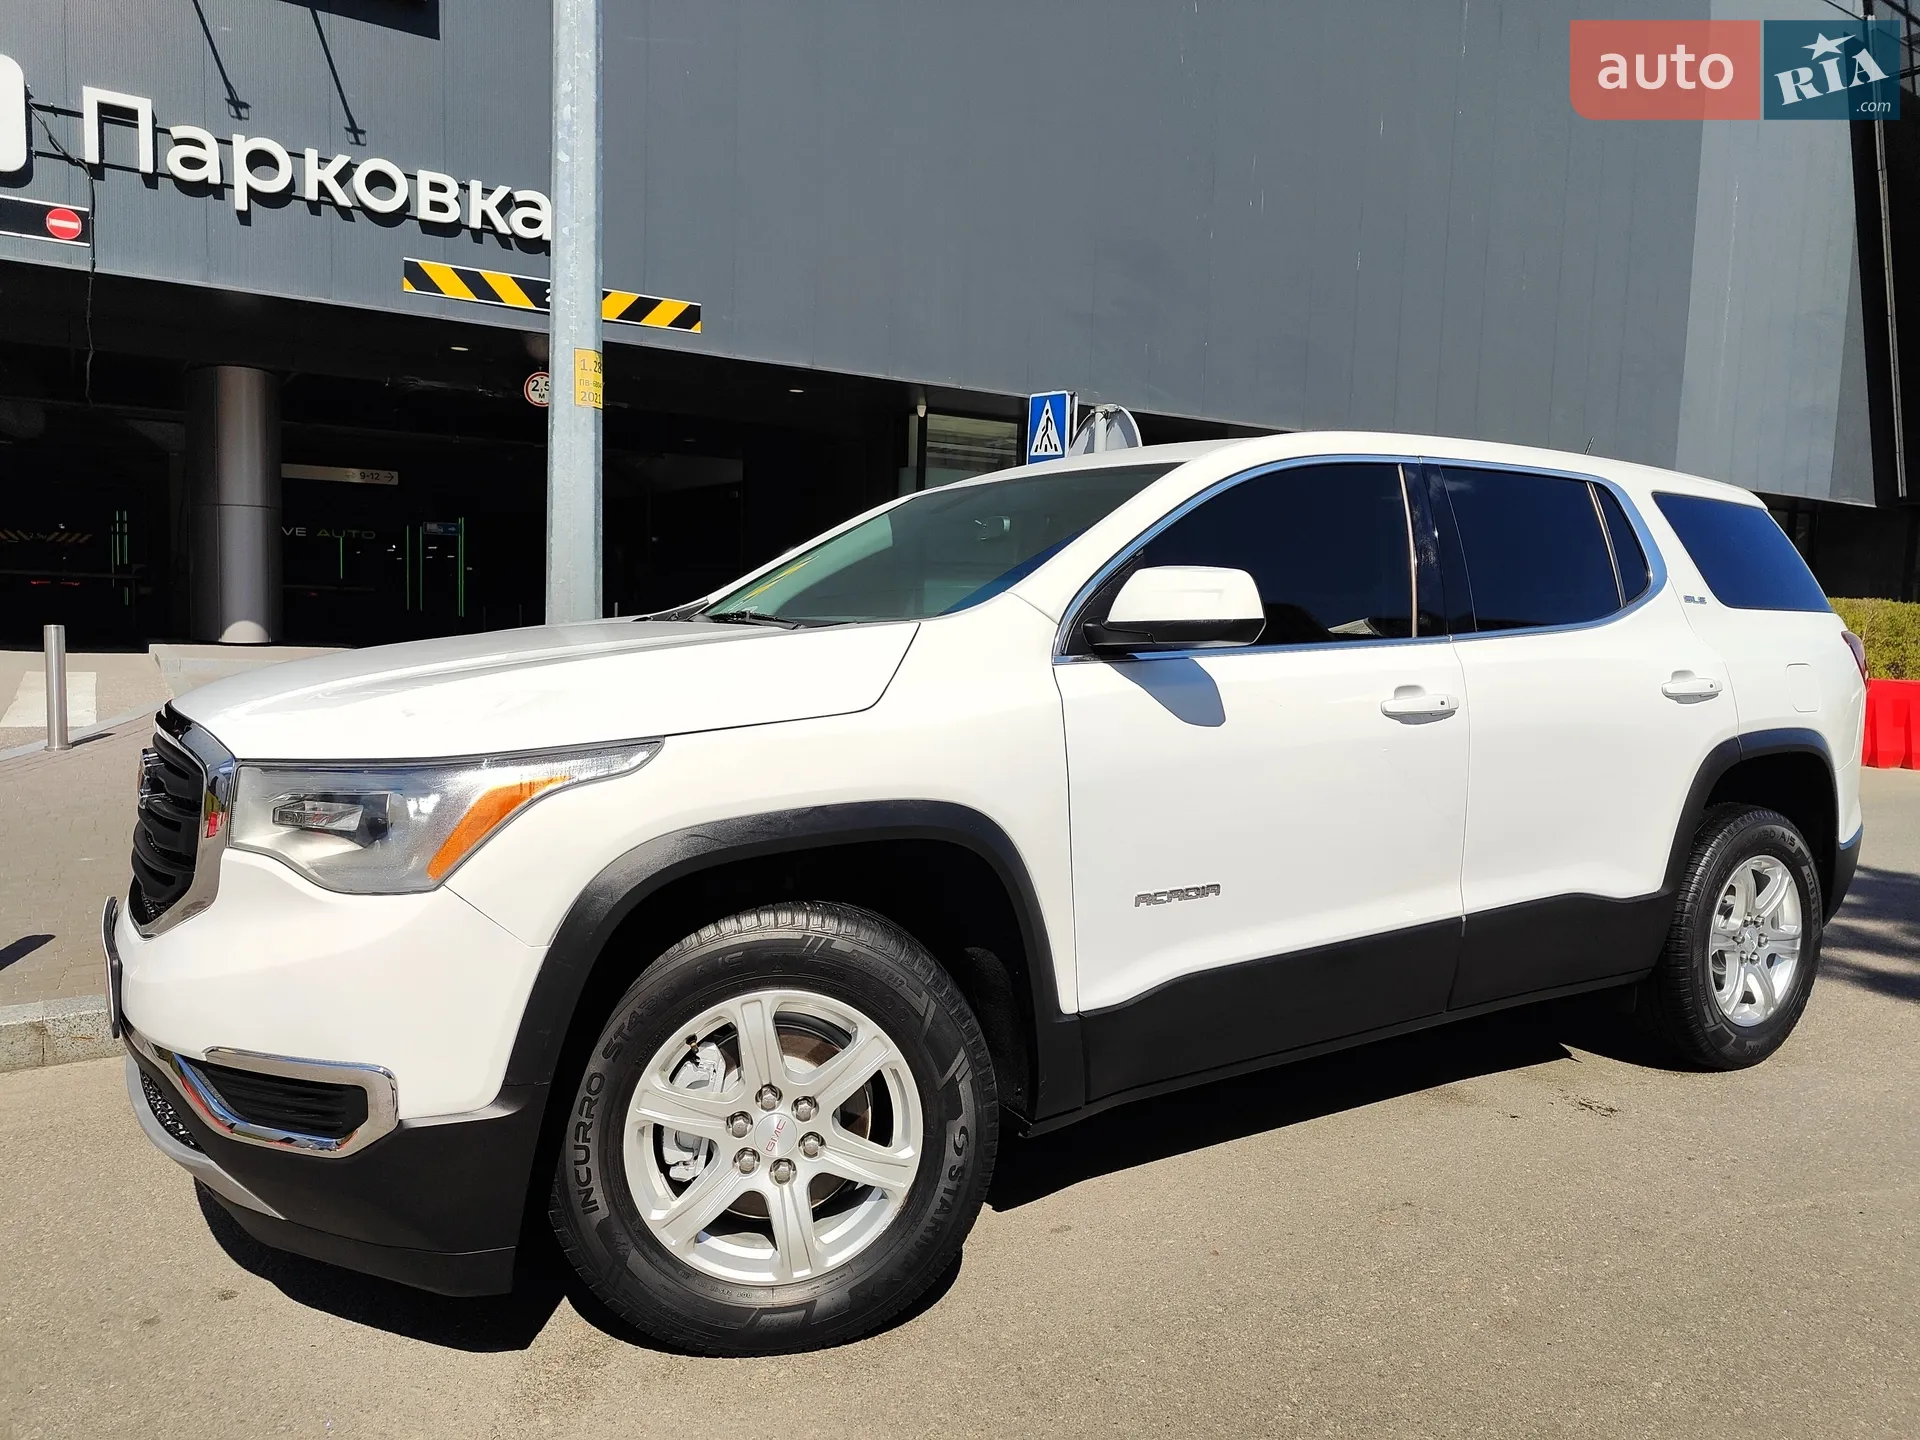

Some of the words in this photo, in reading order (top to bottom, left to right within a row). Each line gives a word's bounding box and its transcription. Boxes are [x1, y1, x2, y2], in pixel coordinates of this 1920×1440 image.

[82, 86, 552, 242] Парковка
[359, 472, 380, 481] 9-12
[316, 528, 376, 540] AUTO
[1683, 595, 1708, 606] SLE
[1134, 883, 1221, 908] ACADIA
[573, 1071, 606, 1215] INCURRO
[765, 1118, 787, 1152] GMC
